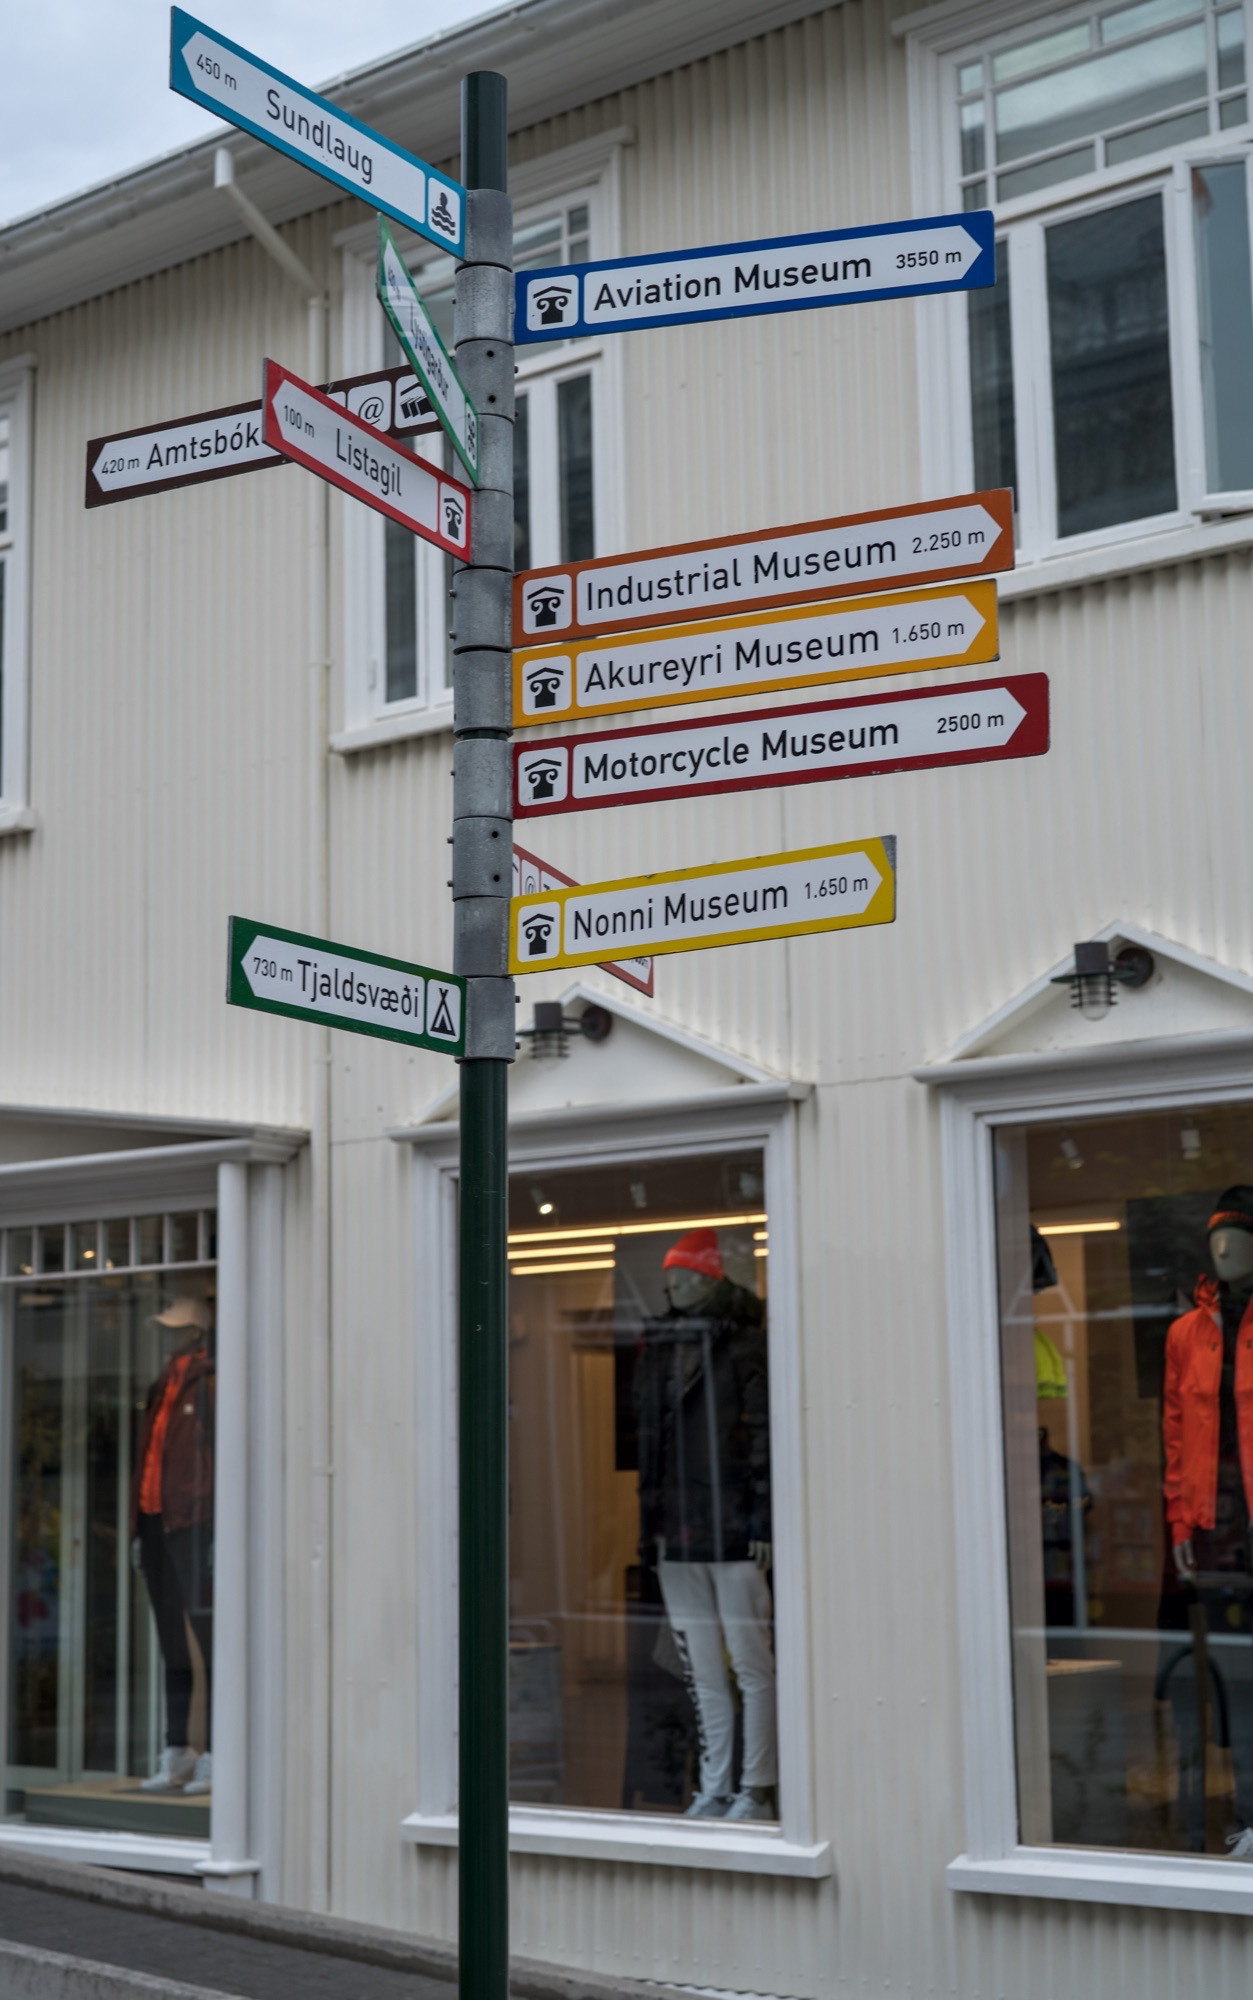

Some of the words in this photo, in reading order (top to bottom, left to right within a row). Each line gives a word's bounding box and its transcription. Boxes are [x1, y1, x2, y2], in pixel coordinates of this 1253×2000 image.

[196, 54, 221, 81] 450
[225, 71, 237, 91] m
[266, 88, 373, 185] Sundlaug
[593, 272, 722, 311] Aviation
[733, 255, 872, 294] Museum
[895, 250, 940, 270] 3550
[944, 250, 962, 264] m
[101, 457, 125, 475] 420
[127, 457, 140, 470] m
[283, 404, 303, 430] 100
[304, 421, 315, 438] m
[336, 427, 402, 496] Listagil
[587, 557, 742, 611] Industrial
[753, 539, 896, 584] Museum
[912, 530, 962, 554] 2.250
[967, 529, 985, 545] m
[584, 644, 722, 693] Akureyri
[735, 628, 879, 671] Museum
[892, 622, 941, 645] 1.650
[947, 622, 965, 636] m
[584, 736, 750, 784] Motorcycle
[762, 722, 899, 761] Museum
[936, 713, 981, 734] 2500
[987, 713, 1005, 727] m
[574, 898, 653, 940] Nonni
[664, 884, 788, 926] Museum
[804, 876, 848, 899] 1.650
[852, 876, 869, 892] m
[252, 957, 276, 978] 730
[280, 966, 293, 982] m
[297, 959, 419, 1018] Tjaldsvæði
